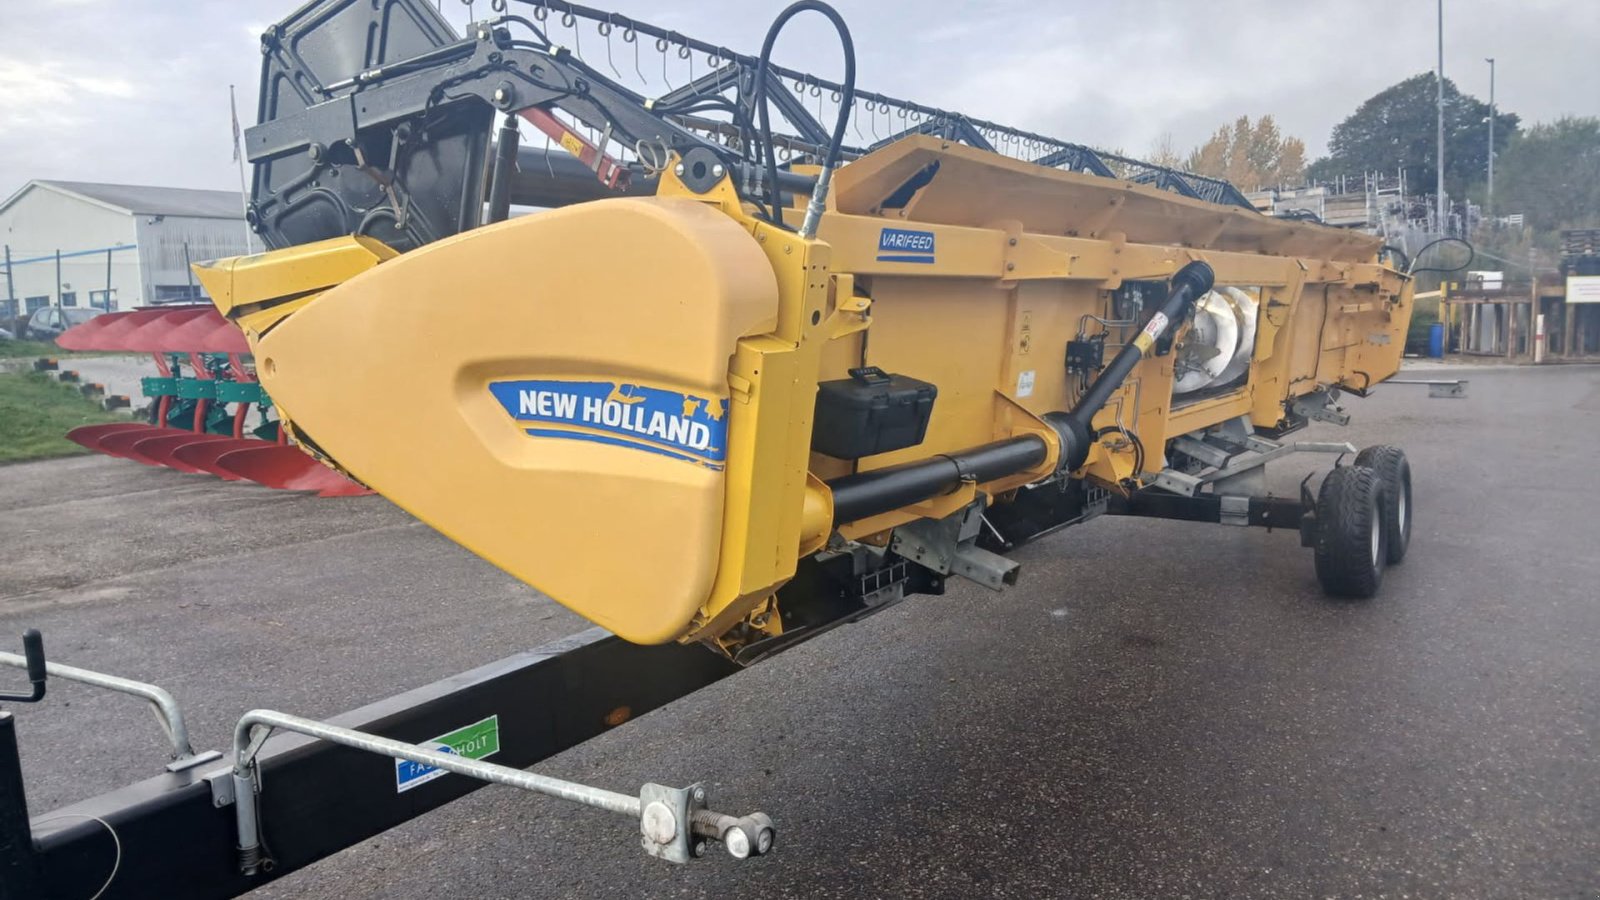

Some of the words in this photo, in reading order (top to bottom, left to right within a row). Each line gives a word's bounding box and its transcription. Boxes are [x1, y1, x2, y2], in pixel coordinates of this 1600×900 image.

[882, 233, 933, 249] VARIFEED
[519, 389, 577, 419] NEW
[583, 396, 711, 450] HOLLAND
